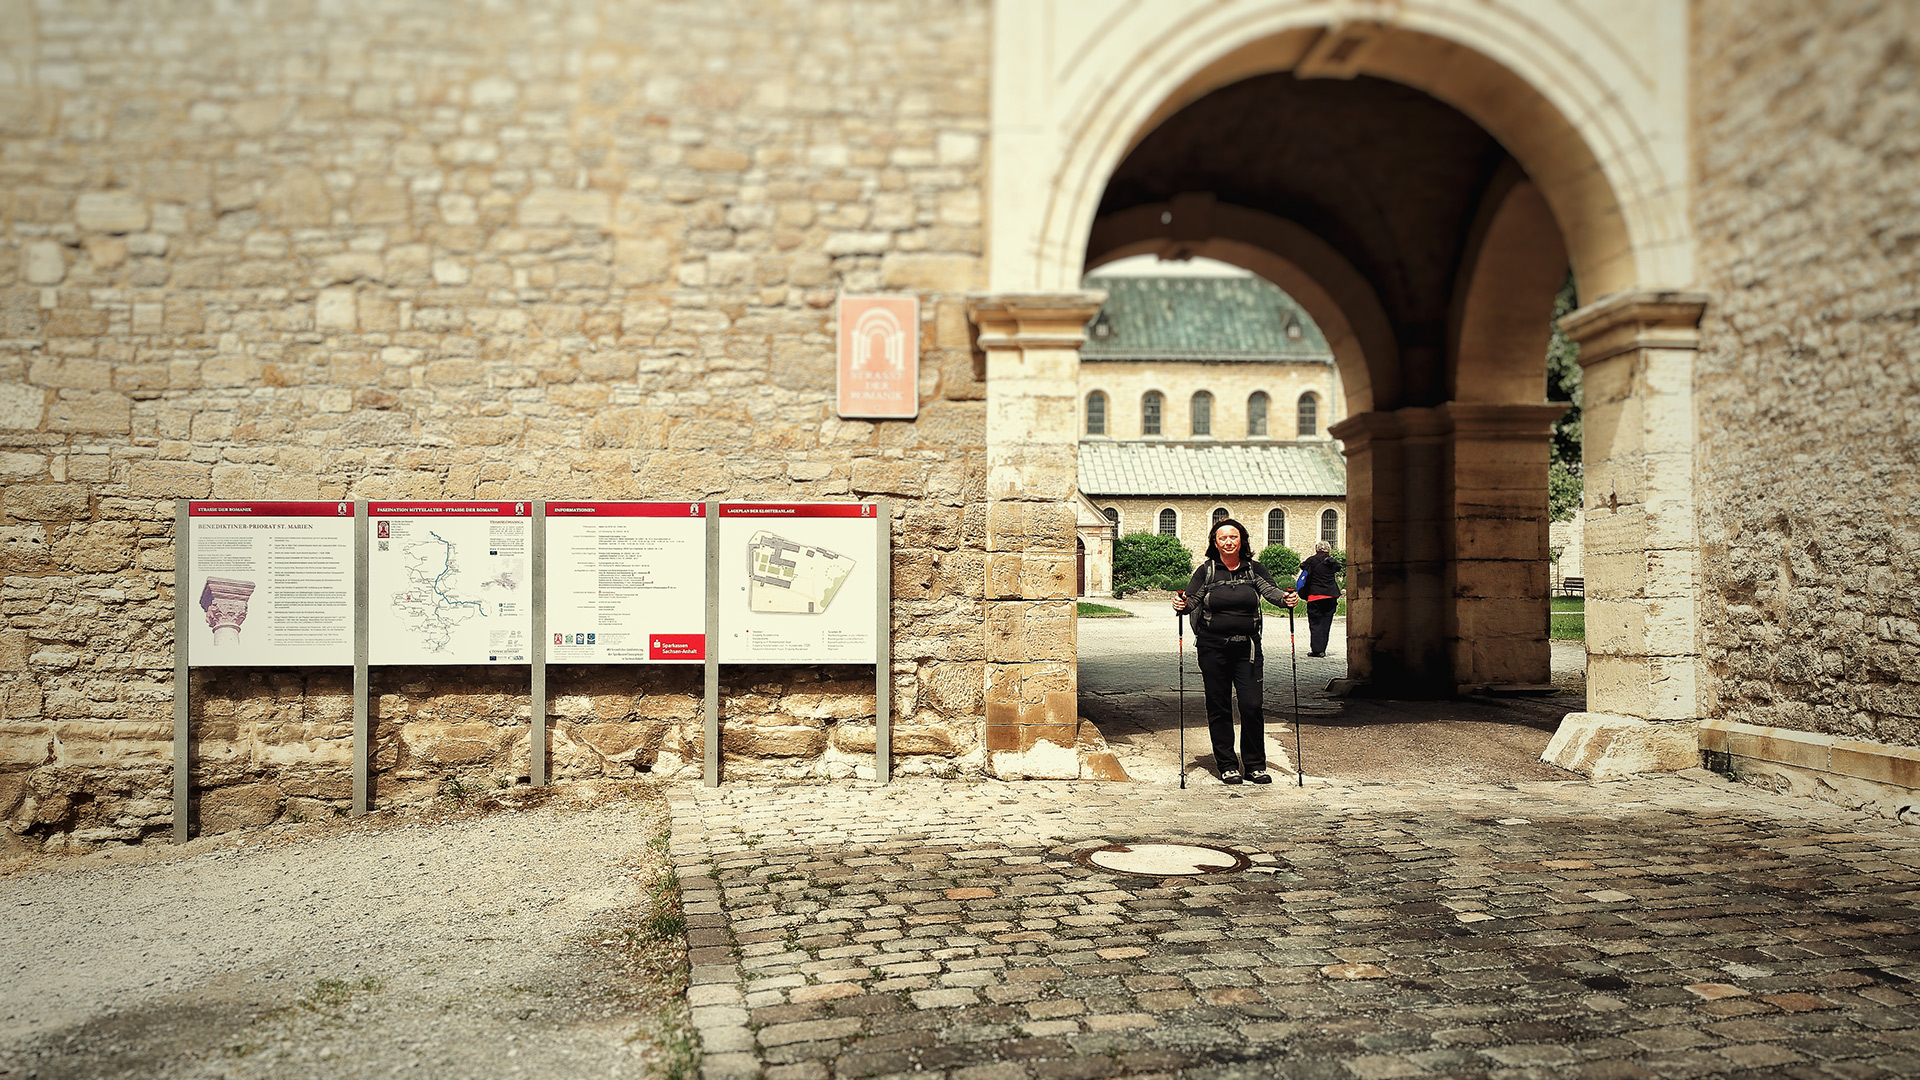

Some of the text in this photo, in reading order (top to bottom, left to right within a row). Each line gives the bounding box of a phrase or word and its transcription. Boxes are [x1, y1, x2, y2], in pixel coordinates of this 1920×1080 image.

[850, 371, 904, 380] STRASSE
[865, 381, 889, 390] DER
[850, 391, 904, 400] ROMANIK
